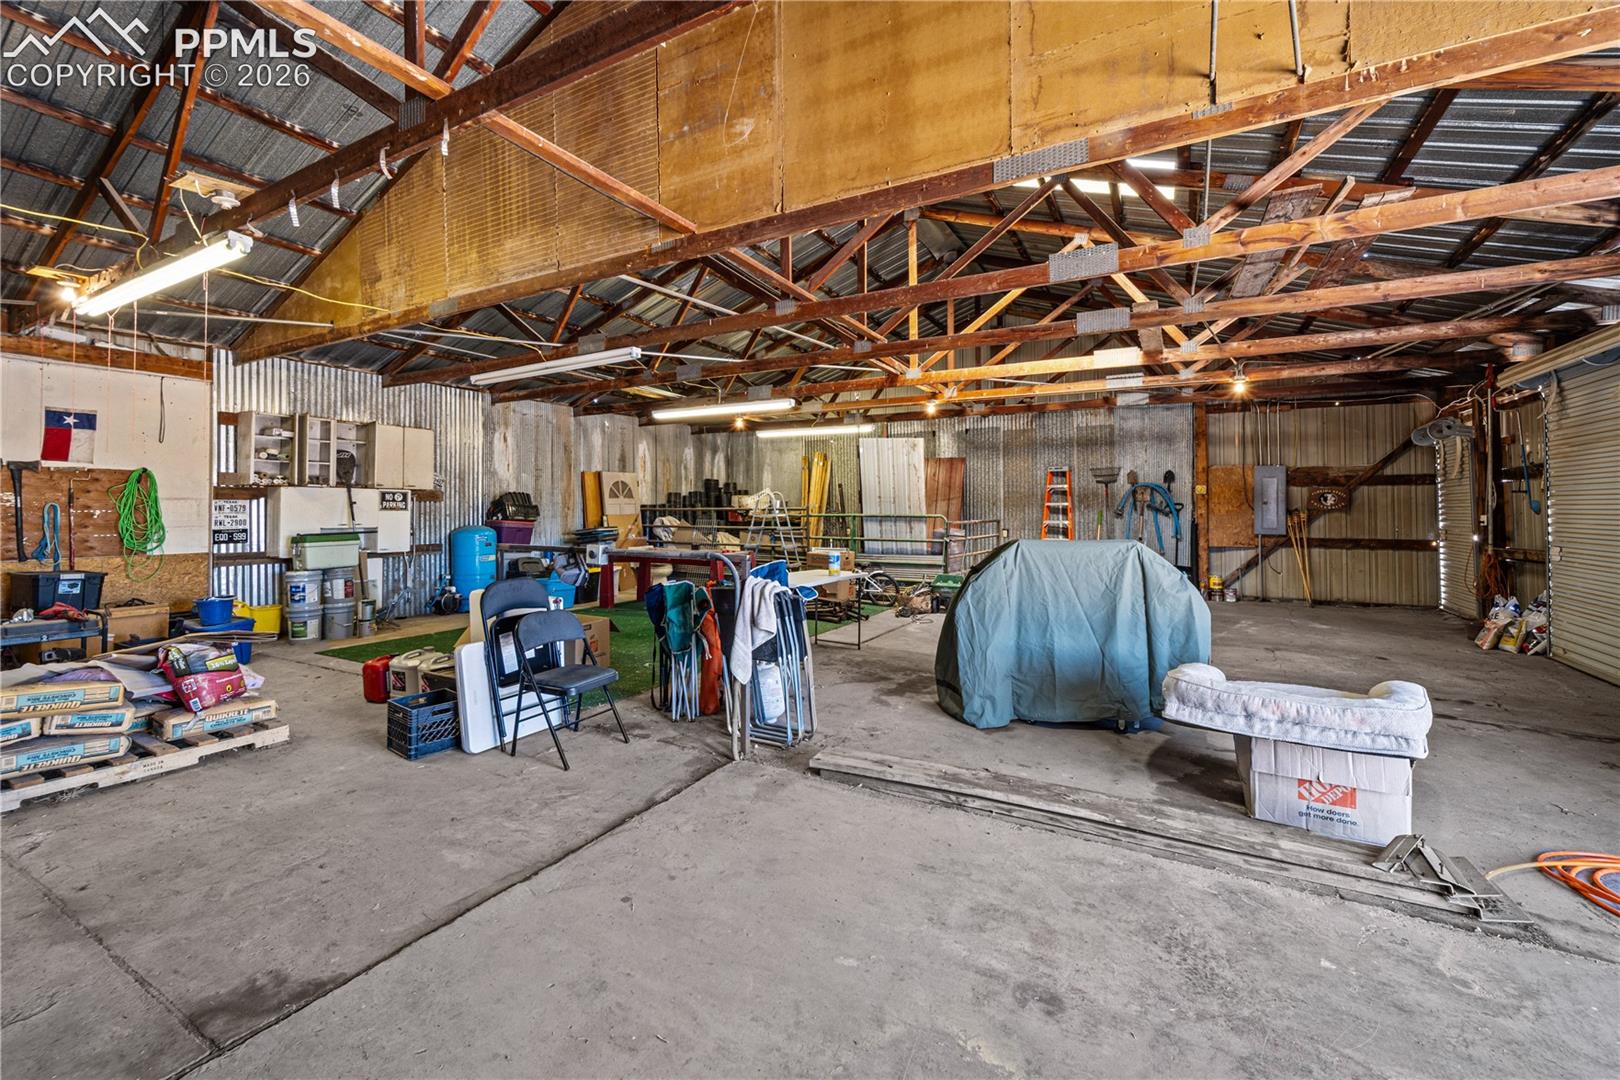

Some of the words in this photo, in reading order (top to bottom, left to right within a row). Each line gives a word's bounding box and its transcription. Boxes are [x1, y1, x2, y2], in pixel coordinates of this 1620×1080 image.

[385, 493, 393, 501] NO
[382, 501, 406, 509] PARKING
[22, 701, 81, 713] QUIKRETE
[22, 755, 81, 771] QUIKRETE
[1306, 804, 1325, 813] How
[1313, 813, 1334, 822] more
